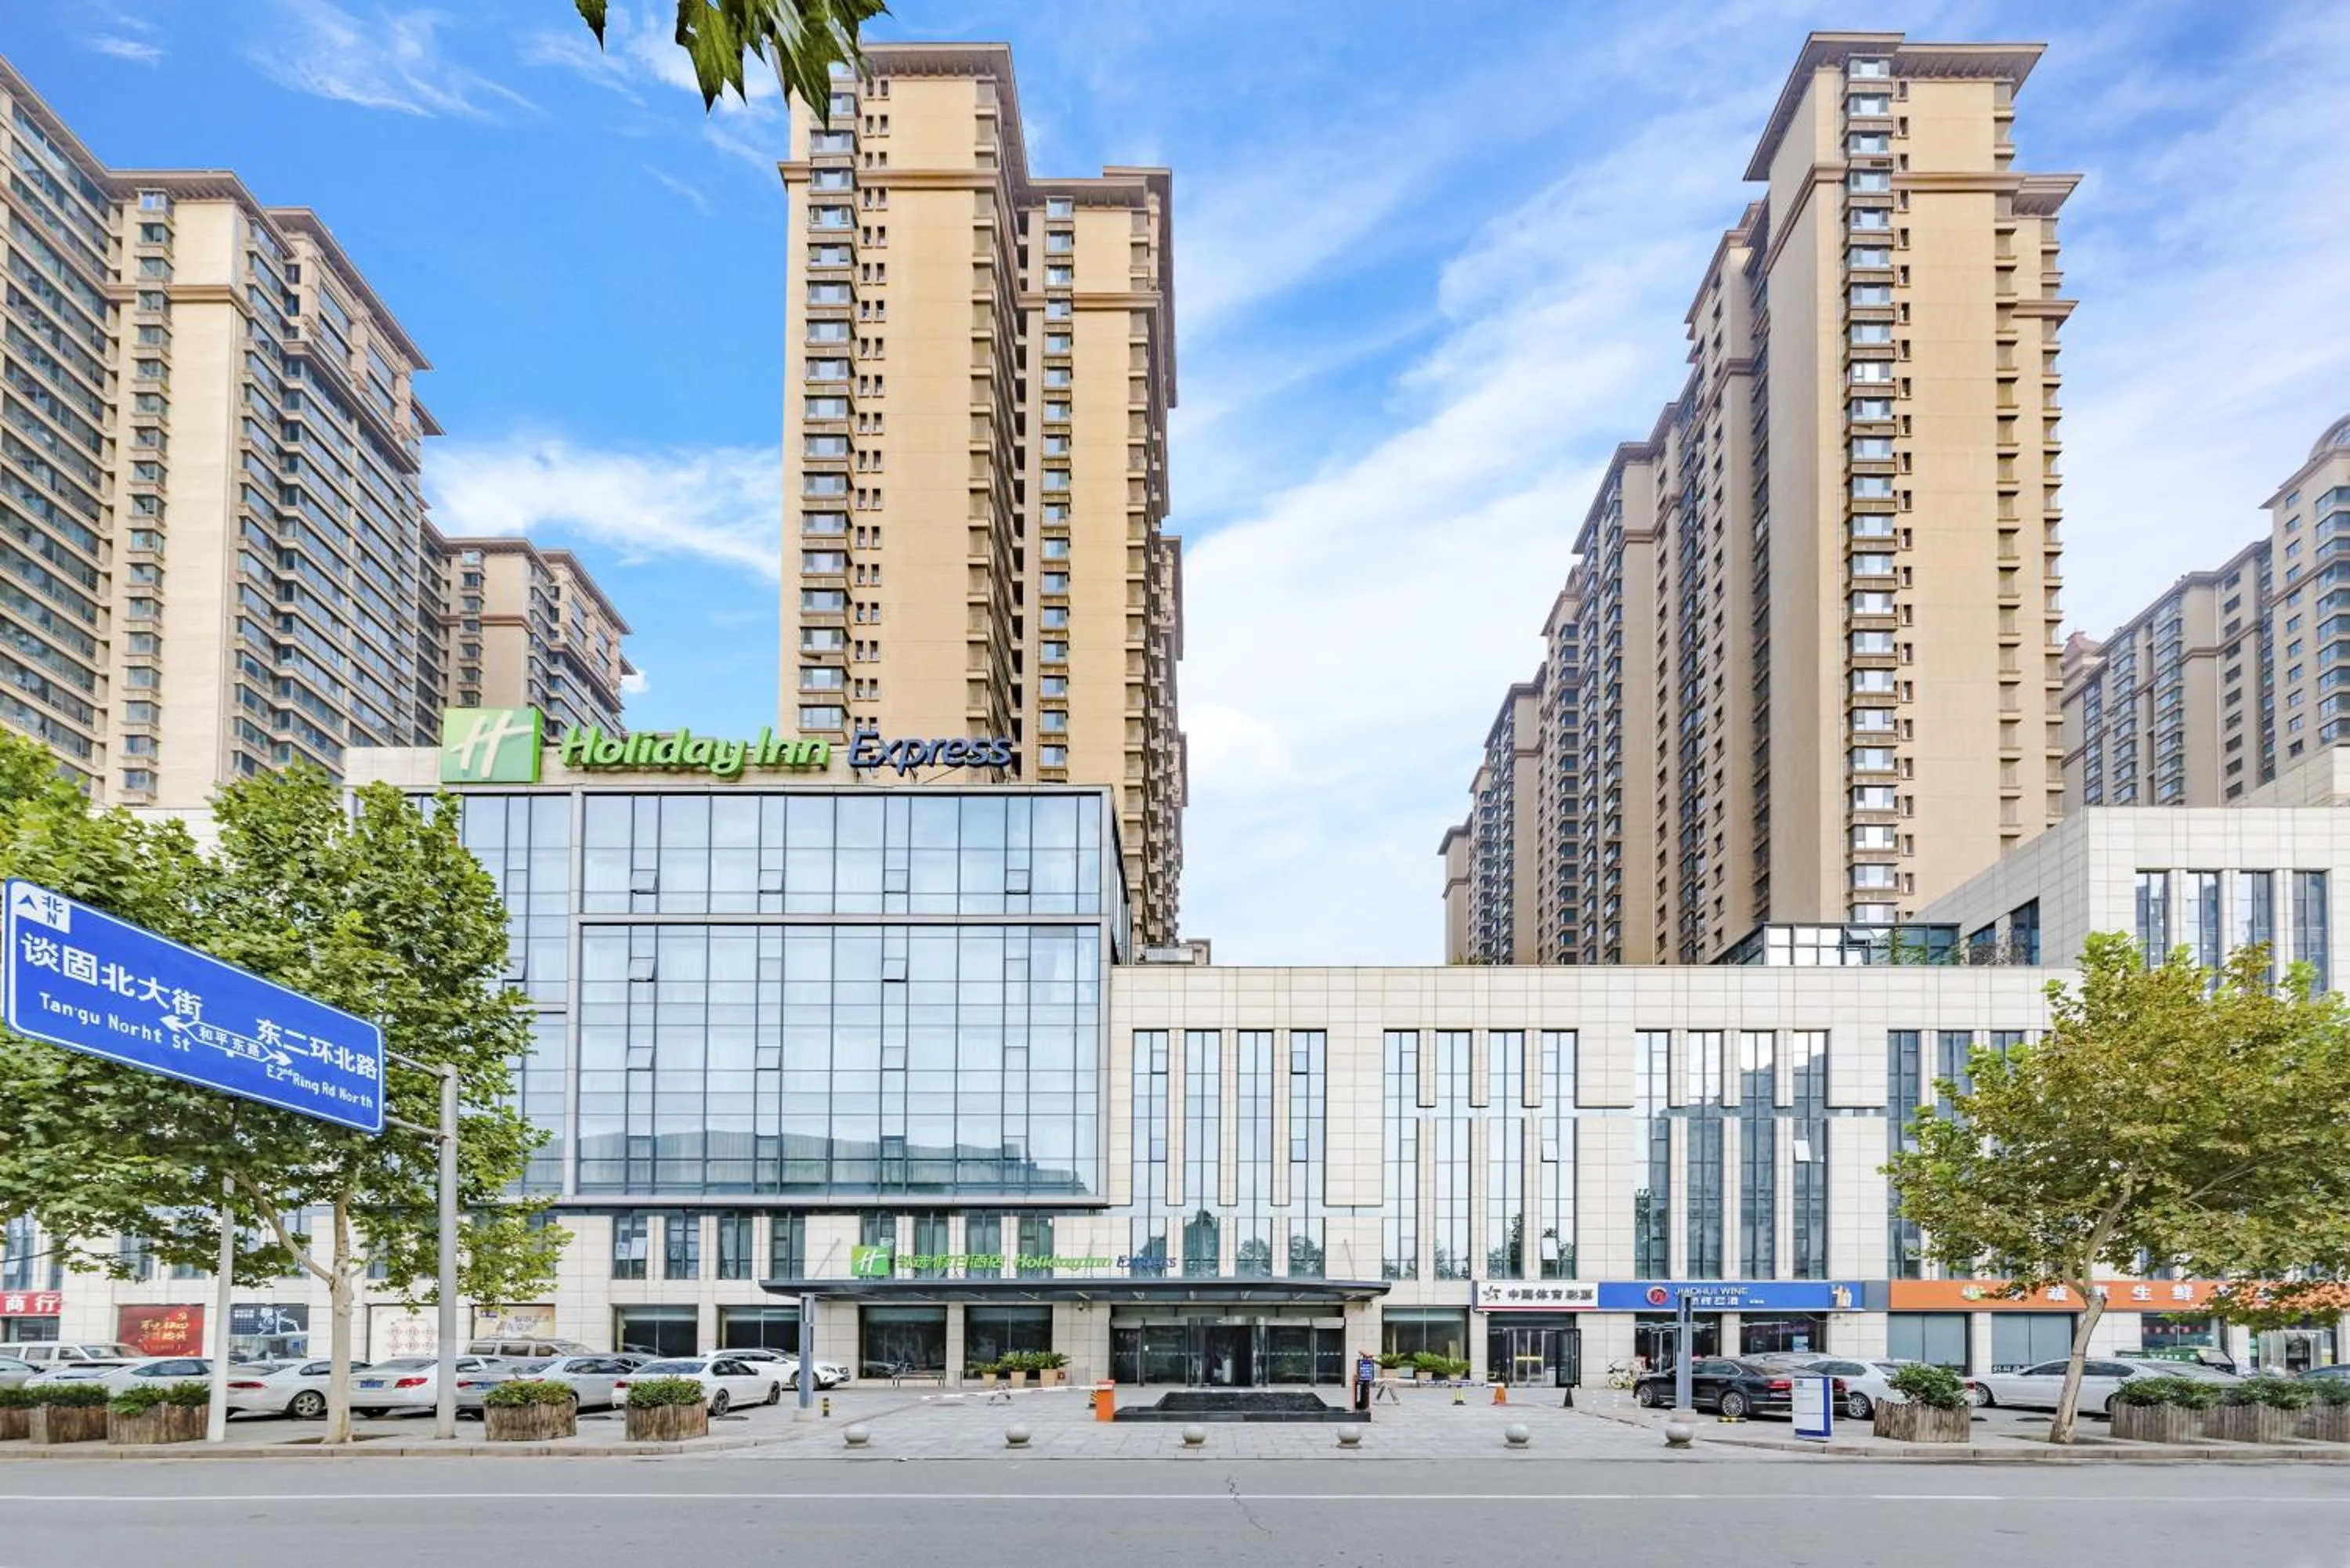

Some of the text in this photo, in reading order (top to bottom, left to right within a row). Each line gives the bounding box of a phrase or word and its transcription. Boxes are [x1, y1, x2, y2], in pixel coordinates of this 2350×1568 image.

[559, 726, 747, 776] Holiday
[753, 726, 830, 770] Inn
[848, 730, 1013, 777] Express
[42, 895, 63, 912] 北
[47, 911, 57, 926] N
[20, 932, 203, 1021] 谈固北大街
[108, 1013, 162, 1043] Norht
[172, 1034, 191, 1052] St
[199, 1026, 259, 1057] 和平东路
[256, 1018, 378, 1080] 东二环北路
[322, 1081, 337, 1097] Rd
[339, 1086, 374, 1108] North
[1719, 1287, 1748, 1295] WINE
